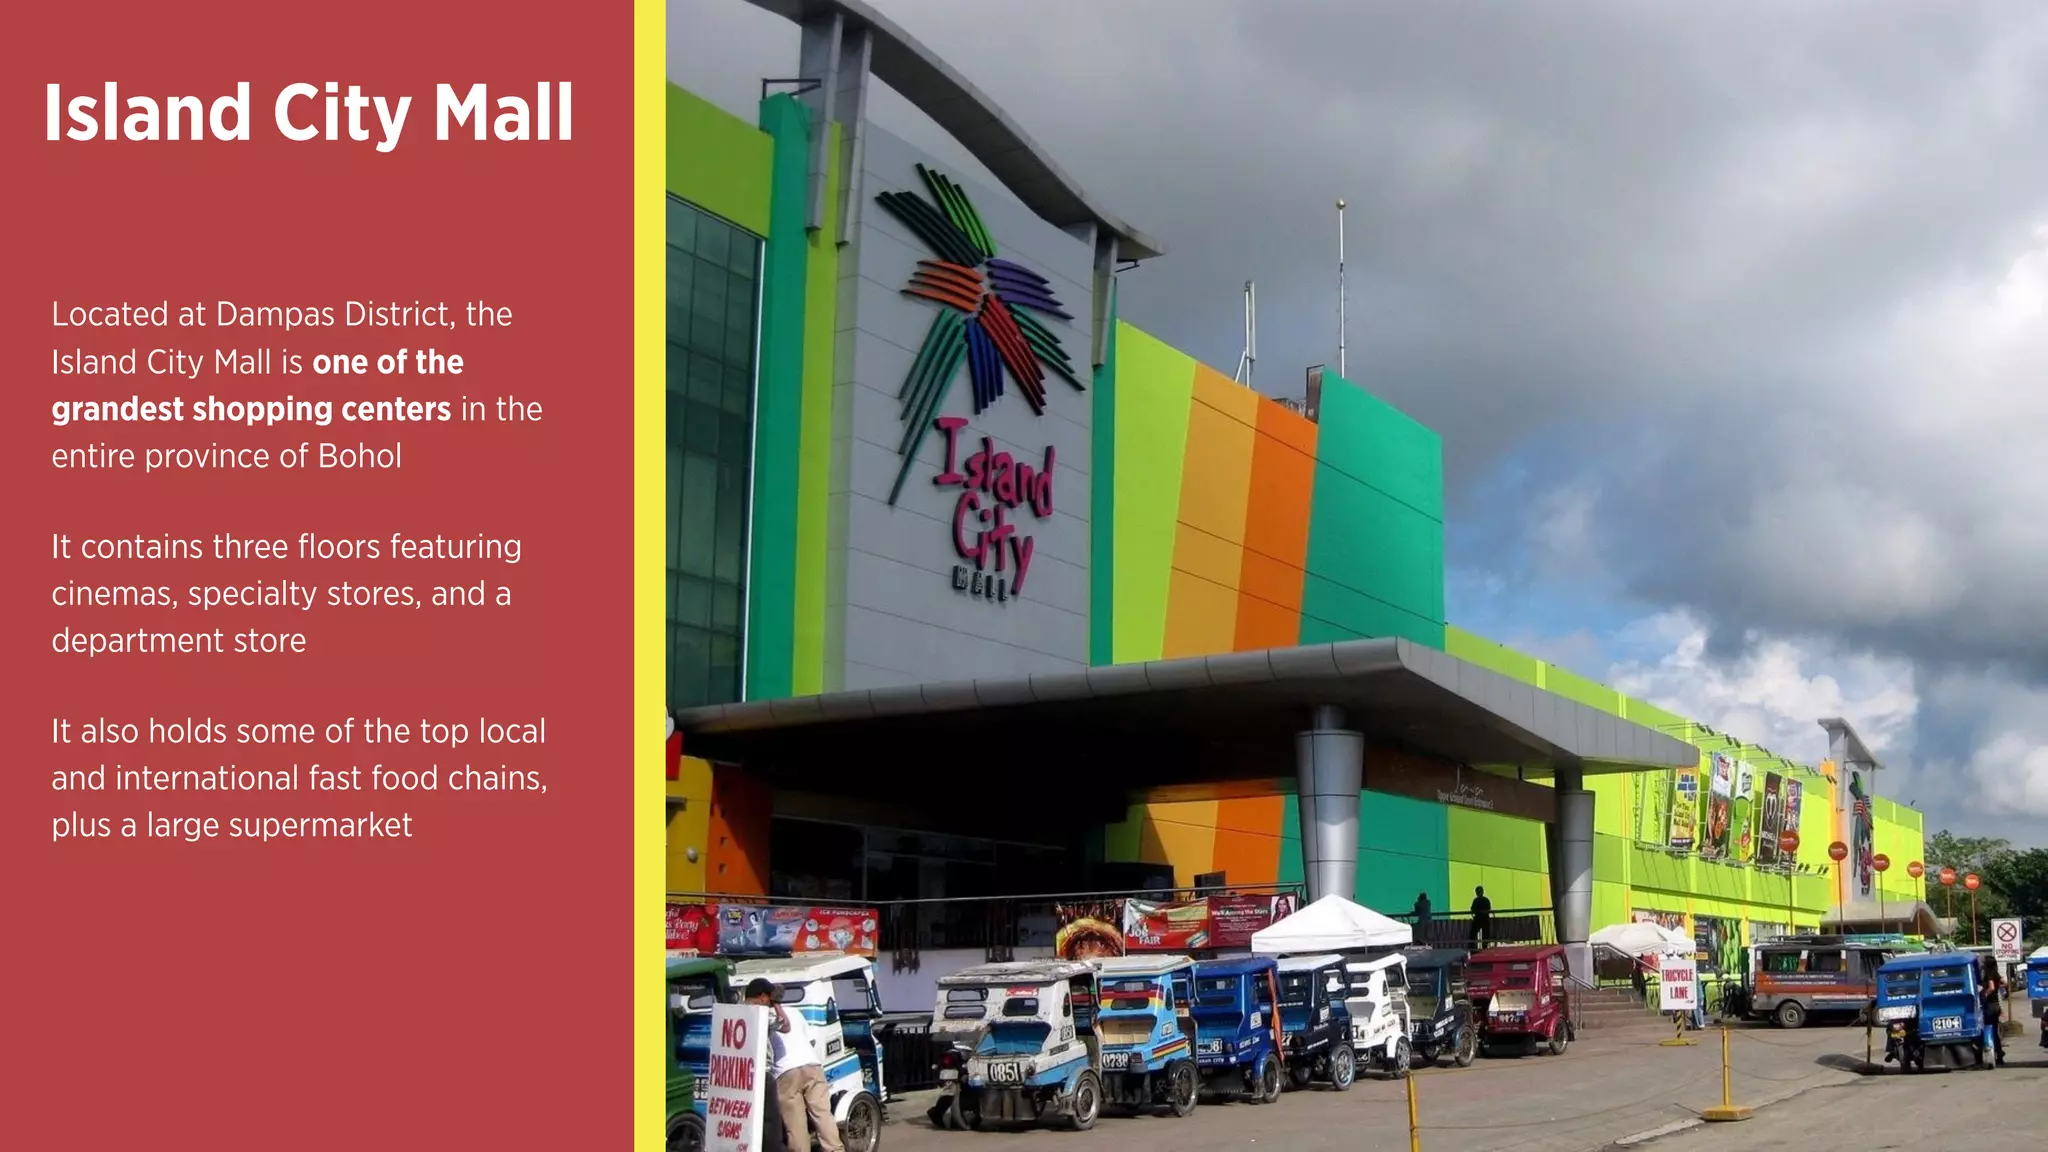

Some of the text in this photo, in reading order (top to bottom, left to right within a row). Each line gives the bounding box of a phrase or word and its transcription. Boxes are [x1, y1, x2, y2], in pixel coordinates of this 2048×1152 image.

[933, 417, 1055, 518] Island
[952, 491, 1034, 595] City
[1129, 927, 1148, 938] JOB
[1139, 936, 1161, 945] FAIR
[1661, 968, 1694, 983] TRICYCLE
[1669, 986, 1689, 1001] LANE
[721, 1018, 747, 1050] NO
[708, 1055, 754, 1092] PARKING
[989, 1062, 1021, 1083] 0851
[708, 1096, 752, 1119] BETWEEN
[717, 1120, 743, 1140] SIGNS
